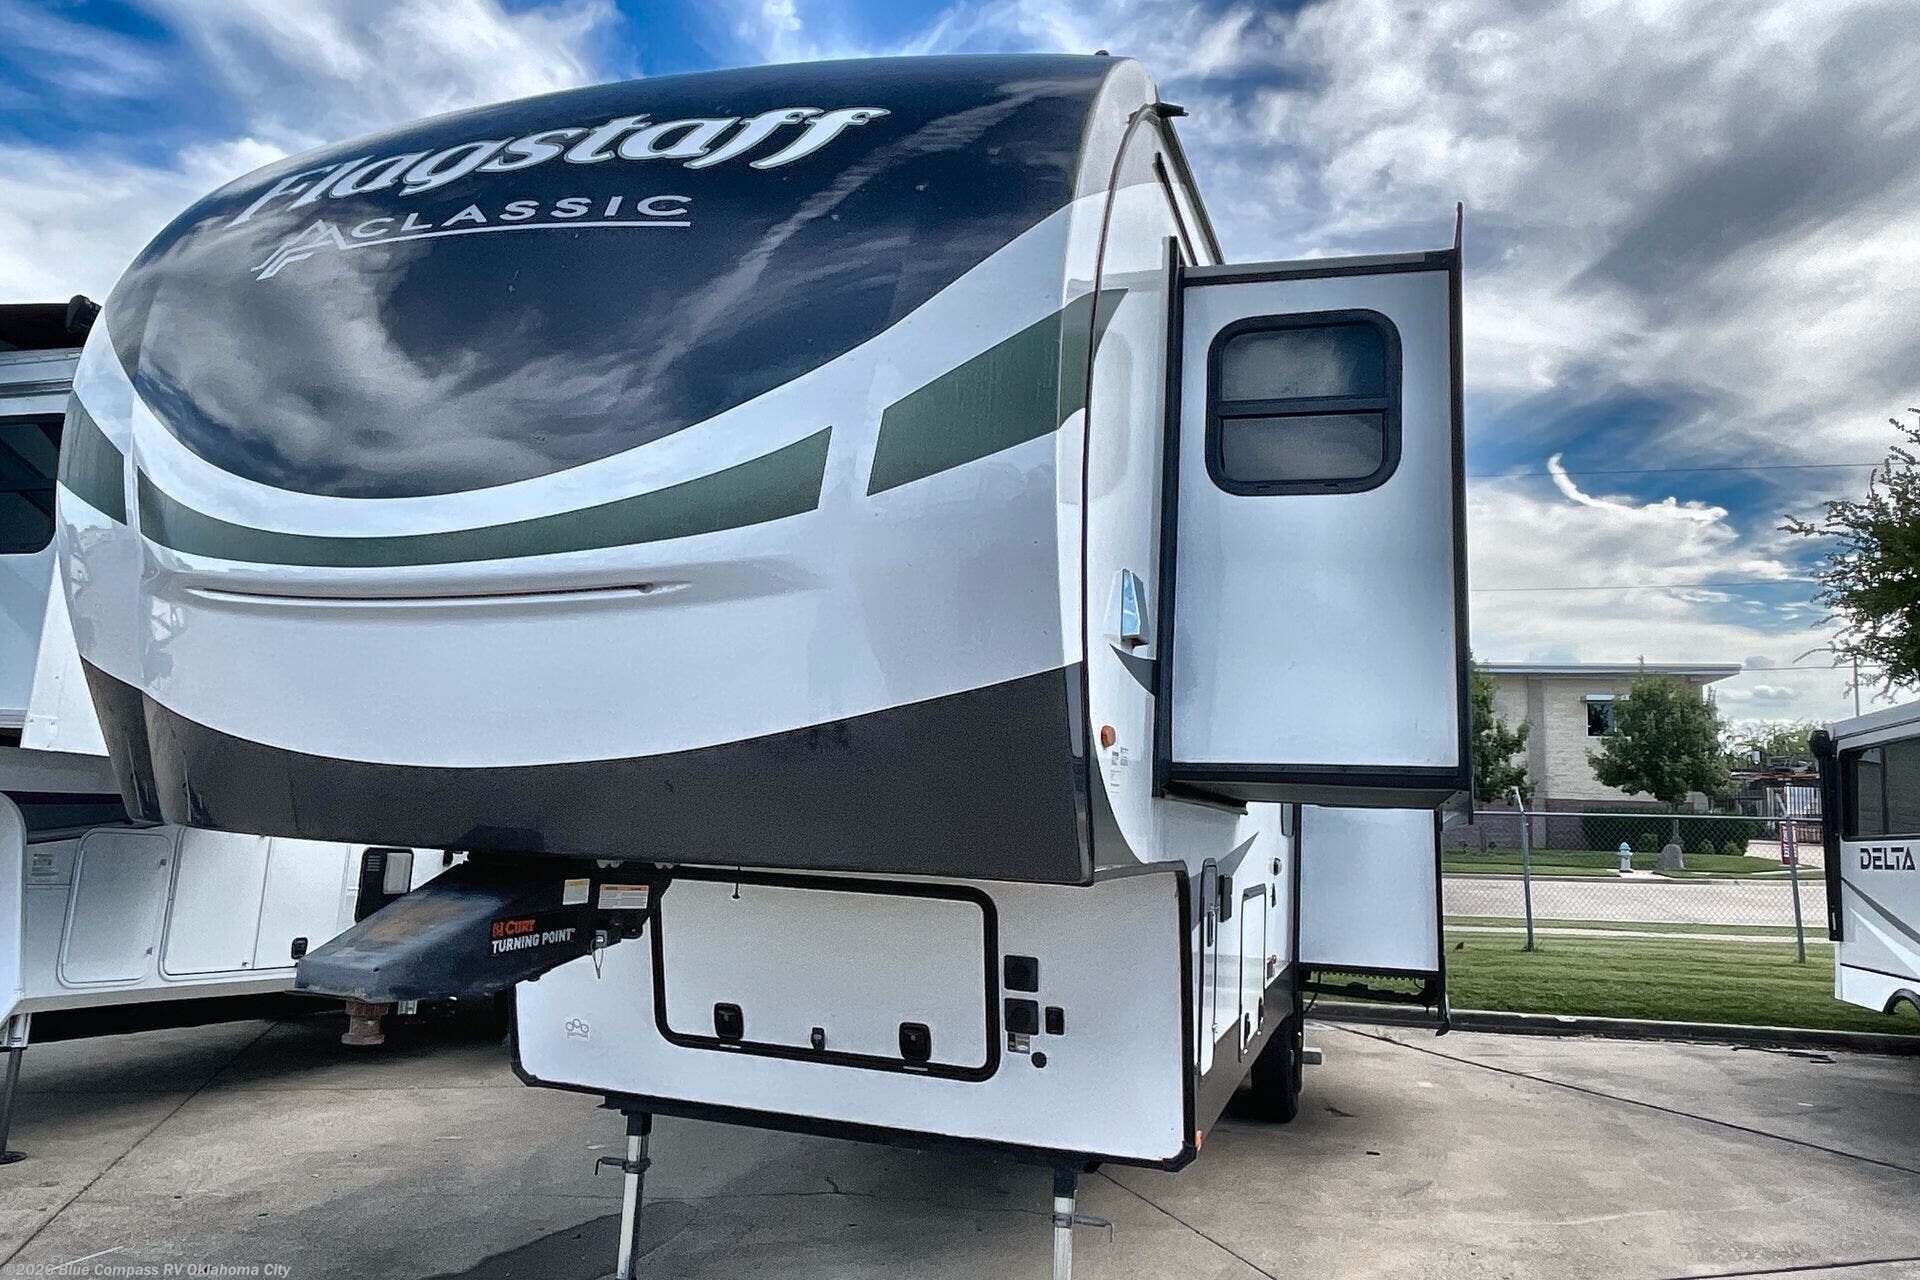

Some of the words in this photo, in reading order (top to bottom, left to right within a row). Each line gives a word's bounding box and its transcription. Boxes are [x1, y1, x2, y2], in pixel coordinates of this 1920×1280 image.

[225, 106, 892, 230] Flagstaff
[351, 195, 692, 238] CLASSIC
[1860, 847, 1916, 870] DELTA
[492, 934, 540, 954] TURNING
